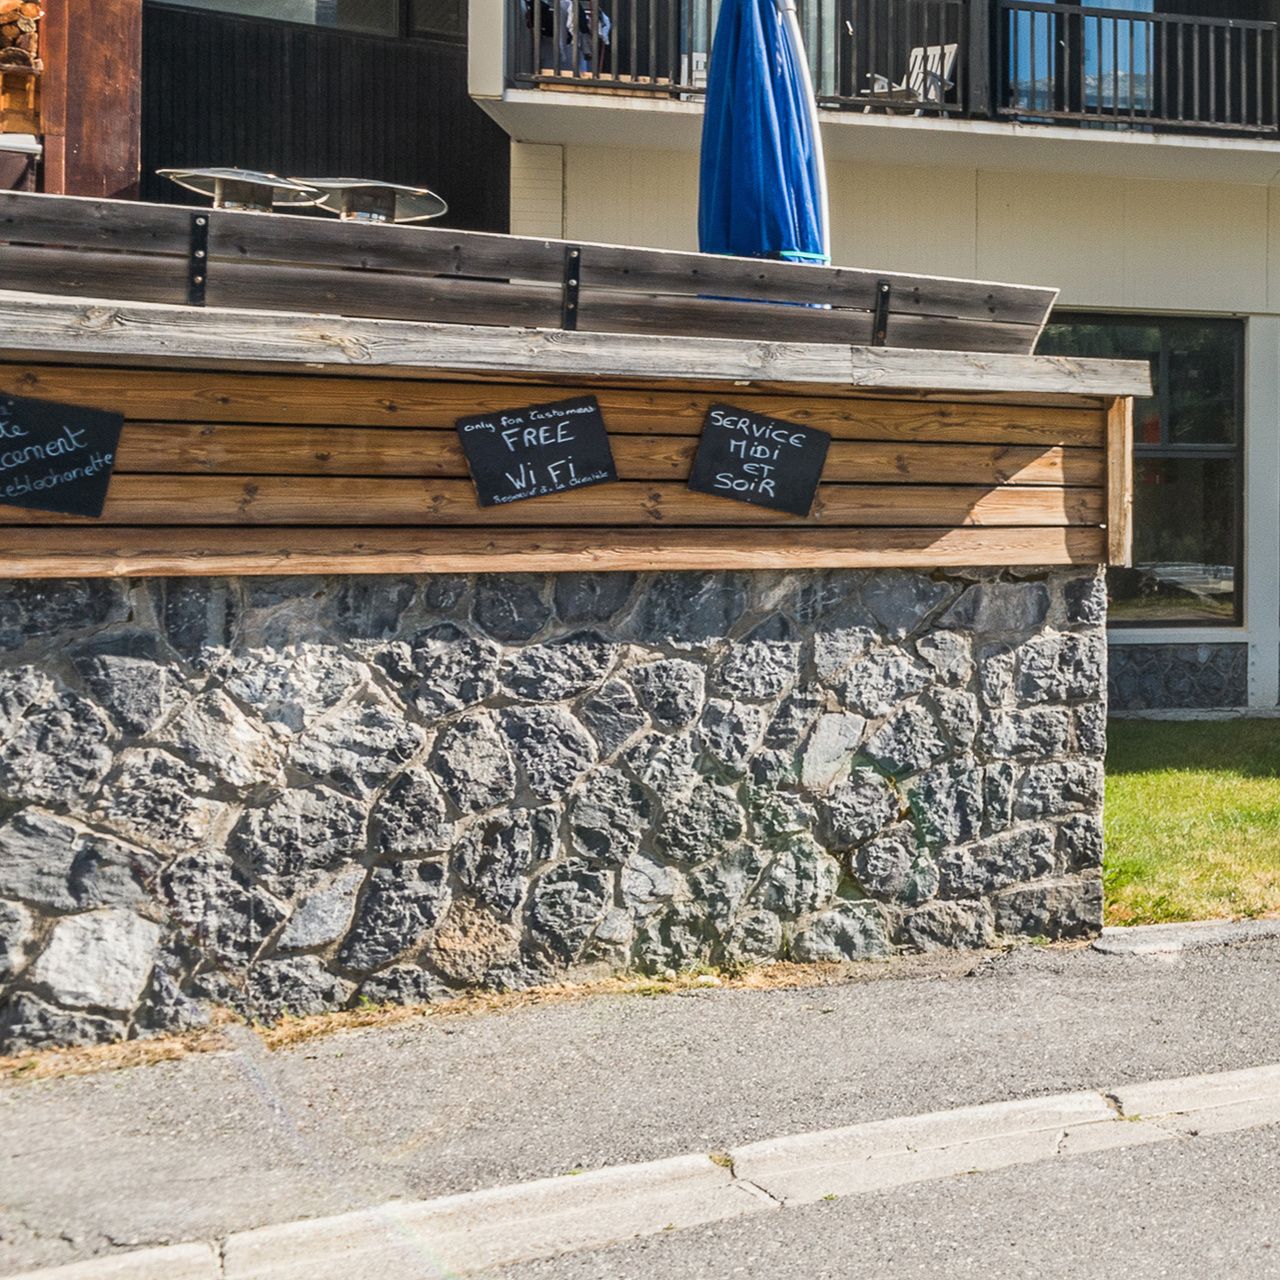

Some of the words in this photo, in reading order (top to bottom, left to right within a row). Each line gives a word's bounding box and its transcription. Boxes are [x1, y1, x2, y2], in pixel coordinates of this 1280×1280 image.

[464, 422, 495, 432] only
[501, 421, 575, 452] FREE
[743, 463, 775, 478] ET
